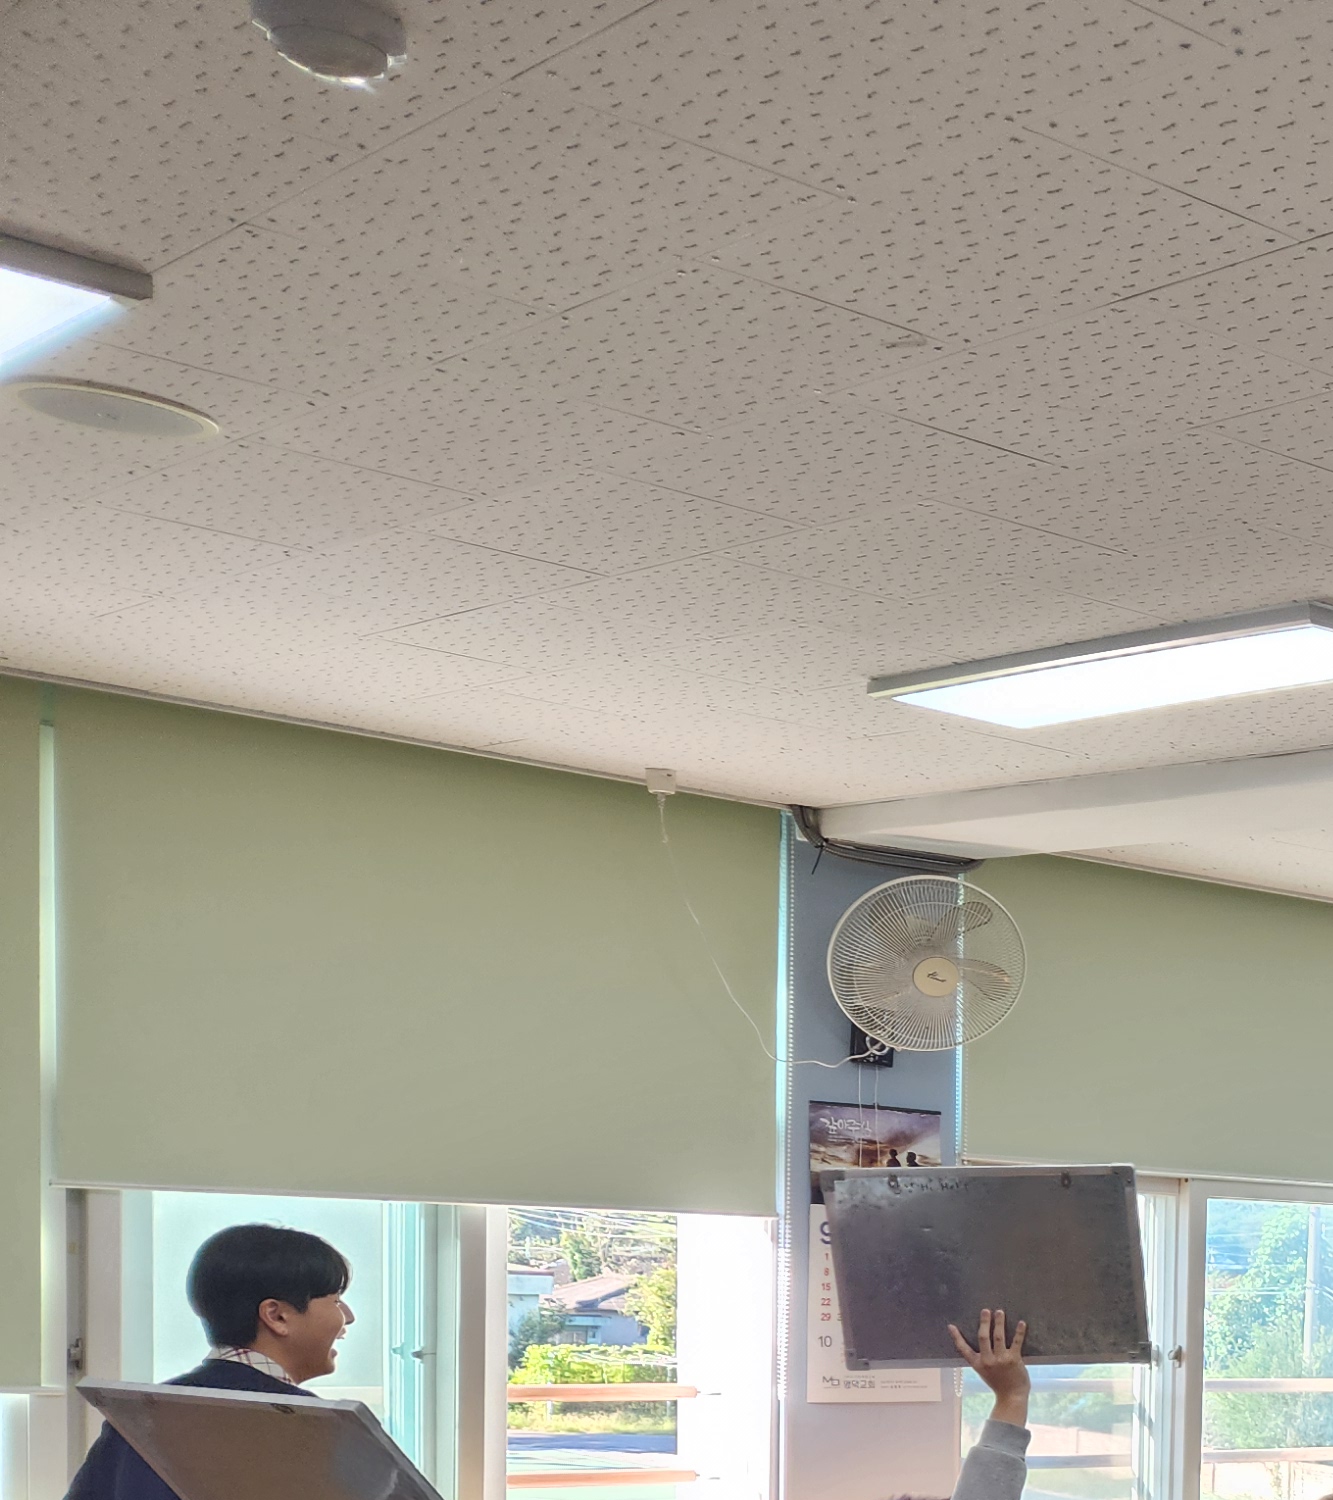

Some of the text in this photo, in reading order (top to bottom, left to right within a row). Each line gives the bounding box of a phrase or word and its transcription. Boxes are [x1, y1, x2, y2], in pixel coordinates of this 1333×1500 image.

[821, 1283, 831, 1291] 15
[821, 1298, 831, 1306] 22
[821, 1313, 831, 1321] 29
[818, 1335, 832, 1348] 10
